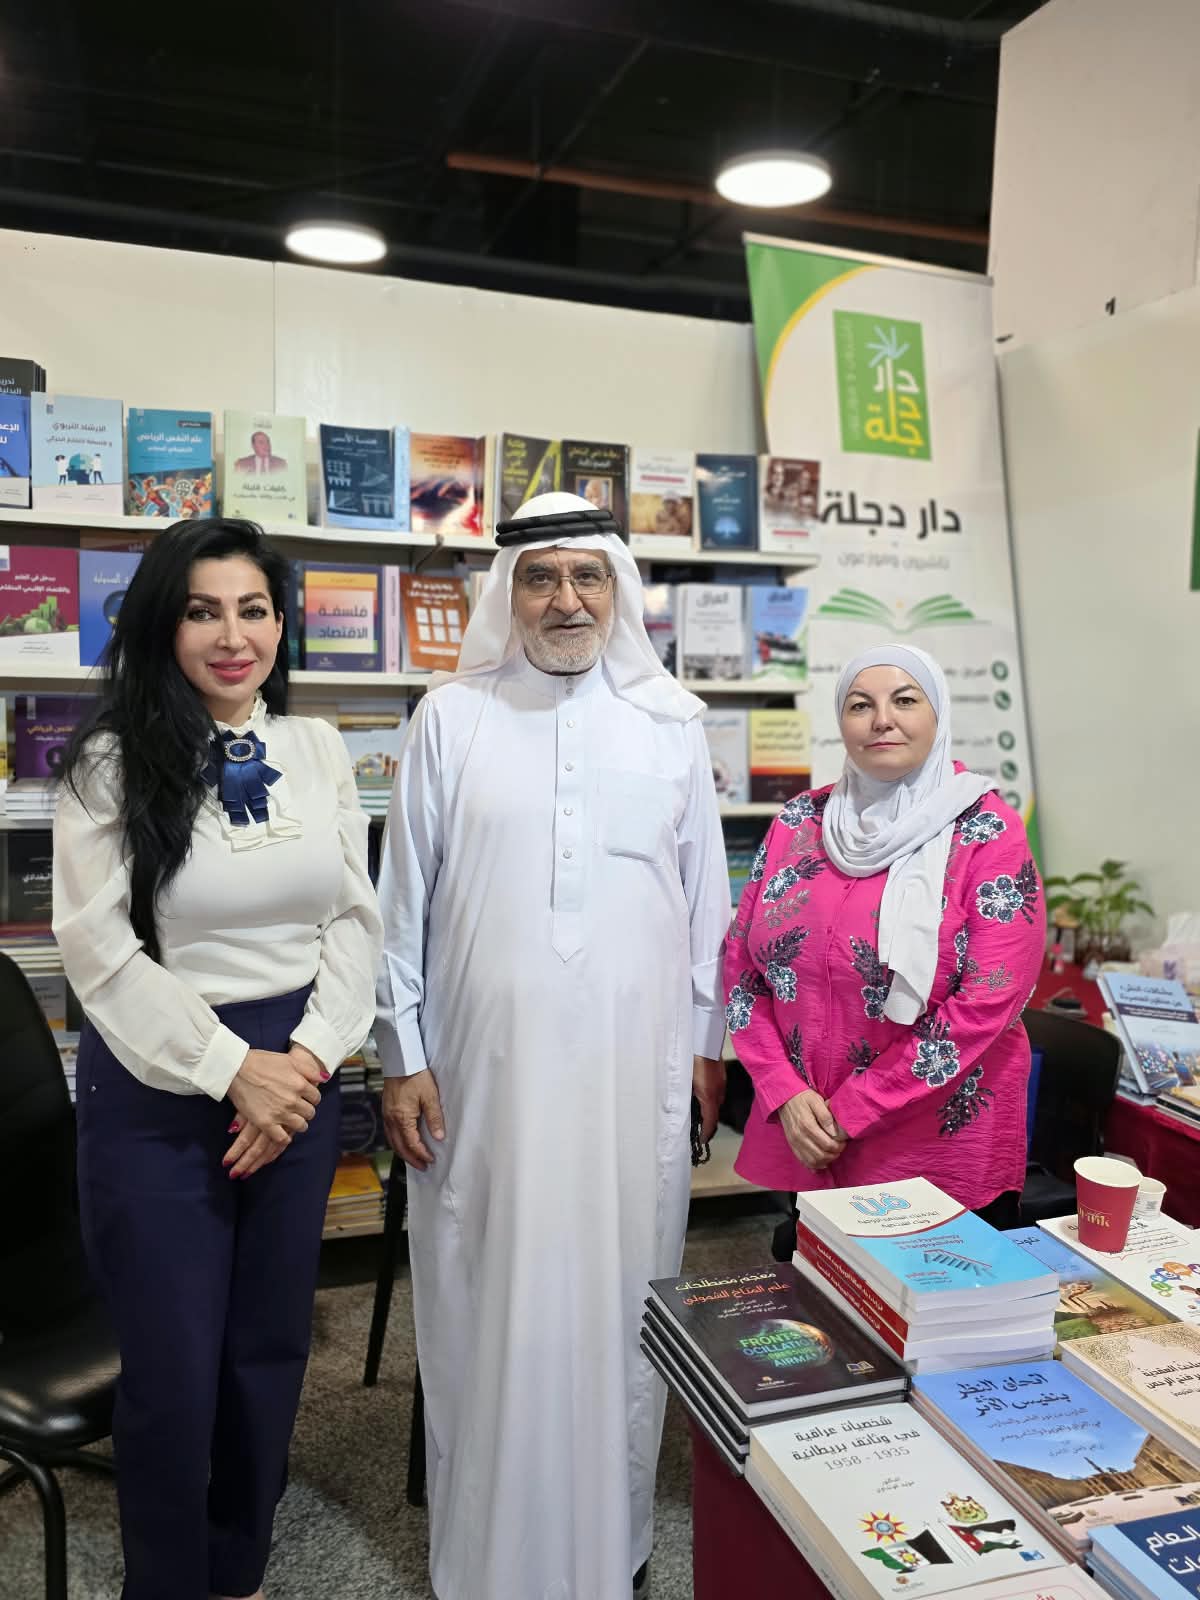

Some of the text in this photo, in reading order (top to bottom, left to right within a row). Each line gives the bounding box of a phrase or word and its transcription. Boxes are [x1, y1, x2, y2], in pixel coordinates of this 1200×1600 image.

[820, 491, 962, 540] دار دجلة
[318, 603, 369, 618] فلسفة
[319, 626, 369, 640] الاقتصاد
[739, 1331, 801, 1348] FRONTS
[956, 1378, 999, 1400] النظر
[793, 1415, 893, 1442] شخصيات عراقية
[791, 1428, 921, 1462] في وثائق بريطانية
[872, 1446, 911, 1461] 1935
[824, 1455, 862, 1472] 1958
